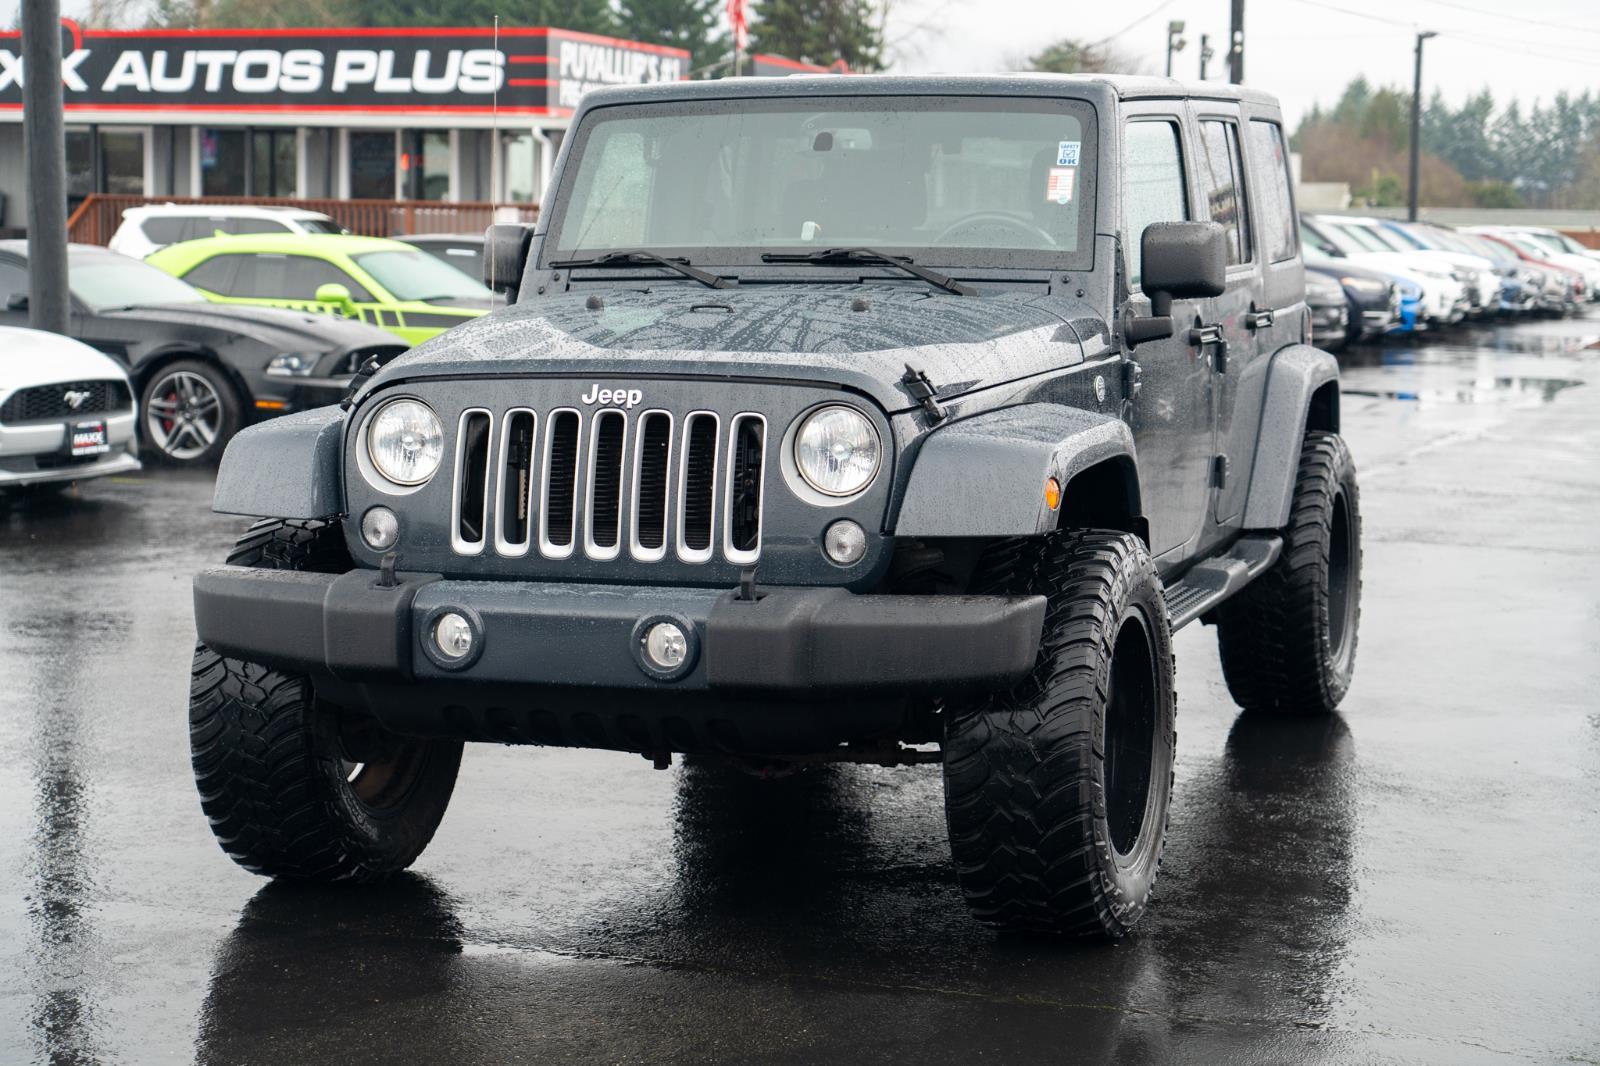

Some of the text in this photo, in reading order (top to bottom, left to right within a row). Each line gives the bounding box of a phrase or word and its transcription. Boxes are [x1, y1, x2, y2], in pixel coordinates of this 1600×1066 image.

[101, 49, 325, 93] AUTOS
[331, 49, 506, 93] PLUS
[560, 40, 659, 83] PUYALLUP'S
[581, 383, 643, 409] Jeep
[74, 432, 104, 445] MAXX
